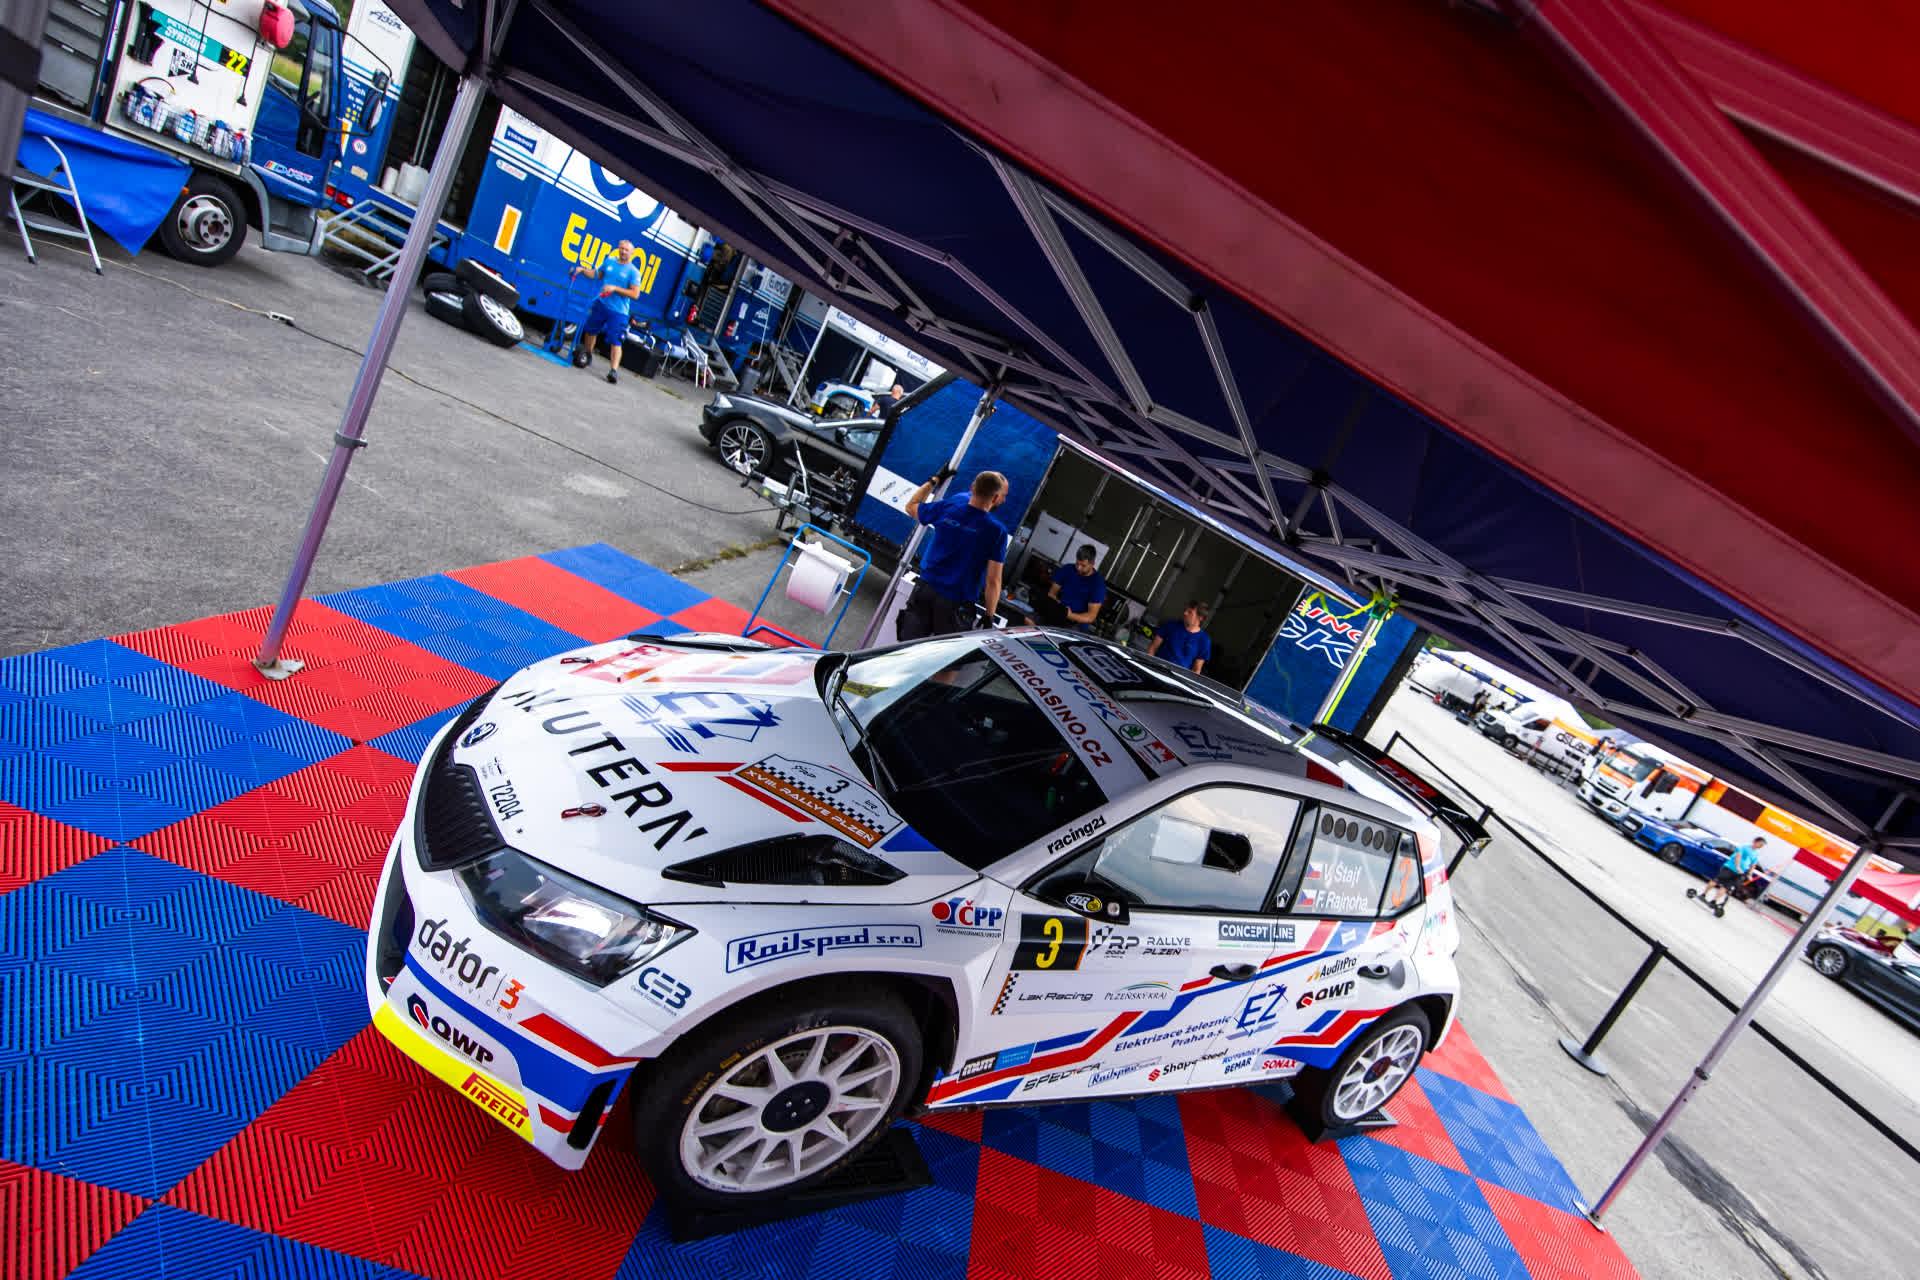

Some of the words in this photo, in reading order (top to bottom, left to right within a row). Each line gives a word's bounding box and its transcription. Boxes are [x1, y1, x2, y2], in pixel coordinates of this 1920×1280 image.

[225, 49, 248, 76] 22
[1039, 651, 1121, 721] DUCK
[490, 779, 524, 821] 72204
[825, 778, 851, 795] 3
[780, 787, 831, 817] RALLYE
[1047, 815, 1108, 855] racing21
[1391, 858, 1413, 909] 3
[958, 899, 1003, 927] ČPP
[736, 927, 870, 966] Railsped
[876, 934, 919, 945] s.r.o.
[1035, 918, 1063, 969] 3
[1146, 936, 1192, 947] RALLYE
[1219, 924, 1269, 939] CONCEPT
[1272, 925, 1295, 940] LINE
[418, 919, 500, 990] dator
[1320, 956, 1357, 978] AuditPro
[638, 967, 693, 1010] CEB
[1018, 993, 1043, 1001] Lak
[1044, 992, 1094, 1002] Racing
[1314, 980, 1355, 1001] QWP
[431, 1015, 494, 1065] QWP
[1115, 1029, 1185, 1052] Elektrizace
[1184, 1015, 1233, 1035] železnic
[1171, 1035, 1206, 1049] Praha
[1224, 1057, 1252, 1075] BEMAR
[1262, 1059, 1297, 1070] SONAX
[461, 1072, 529, 1130] PIRELLI
